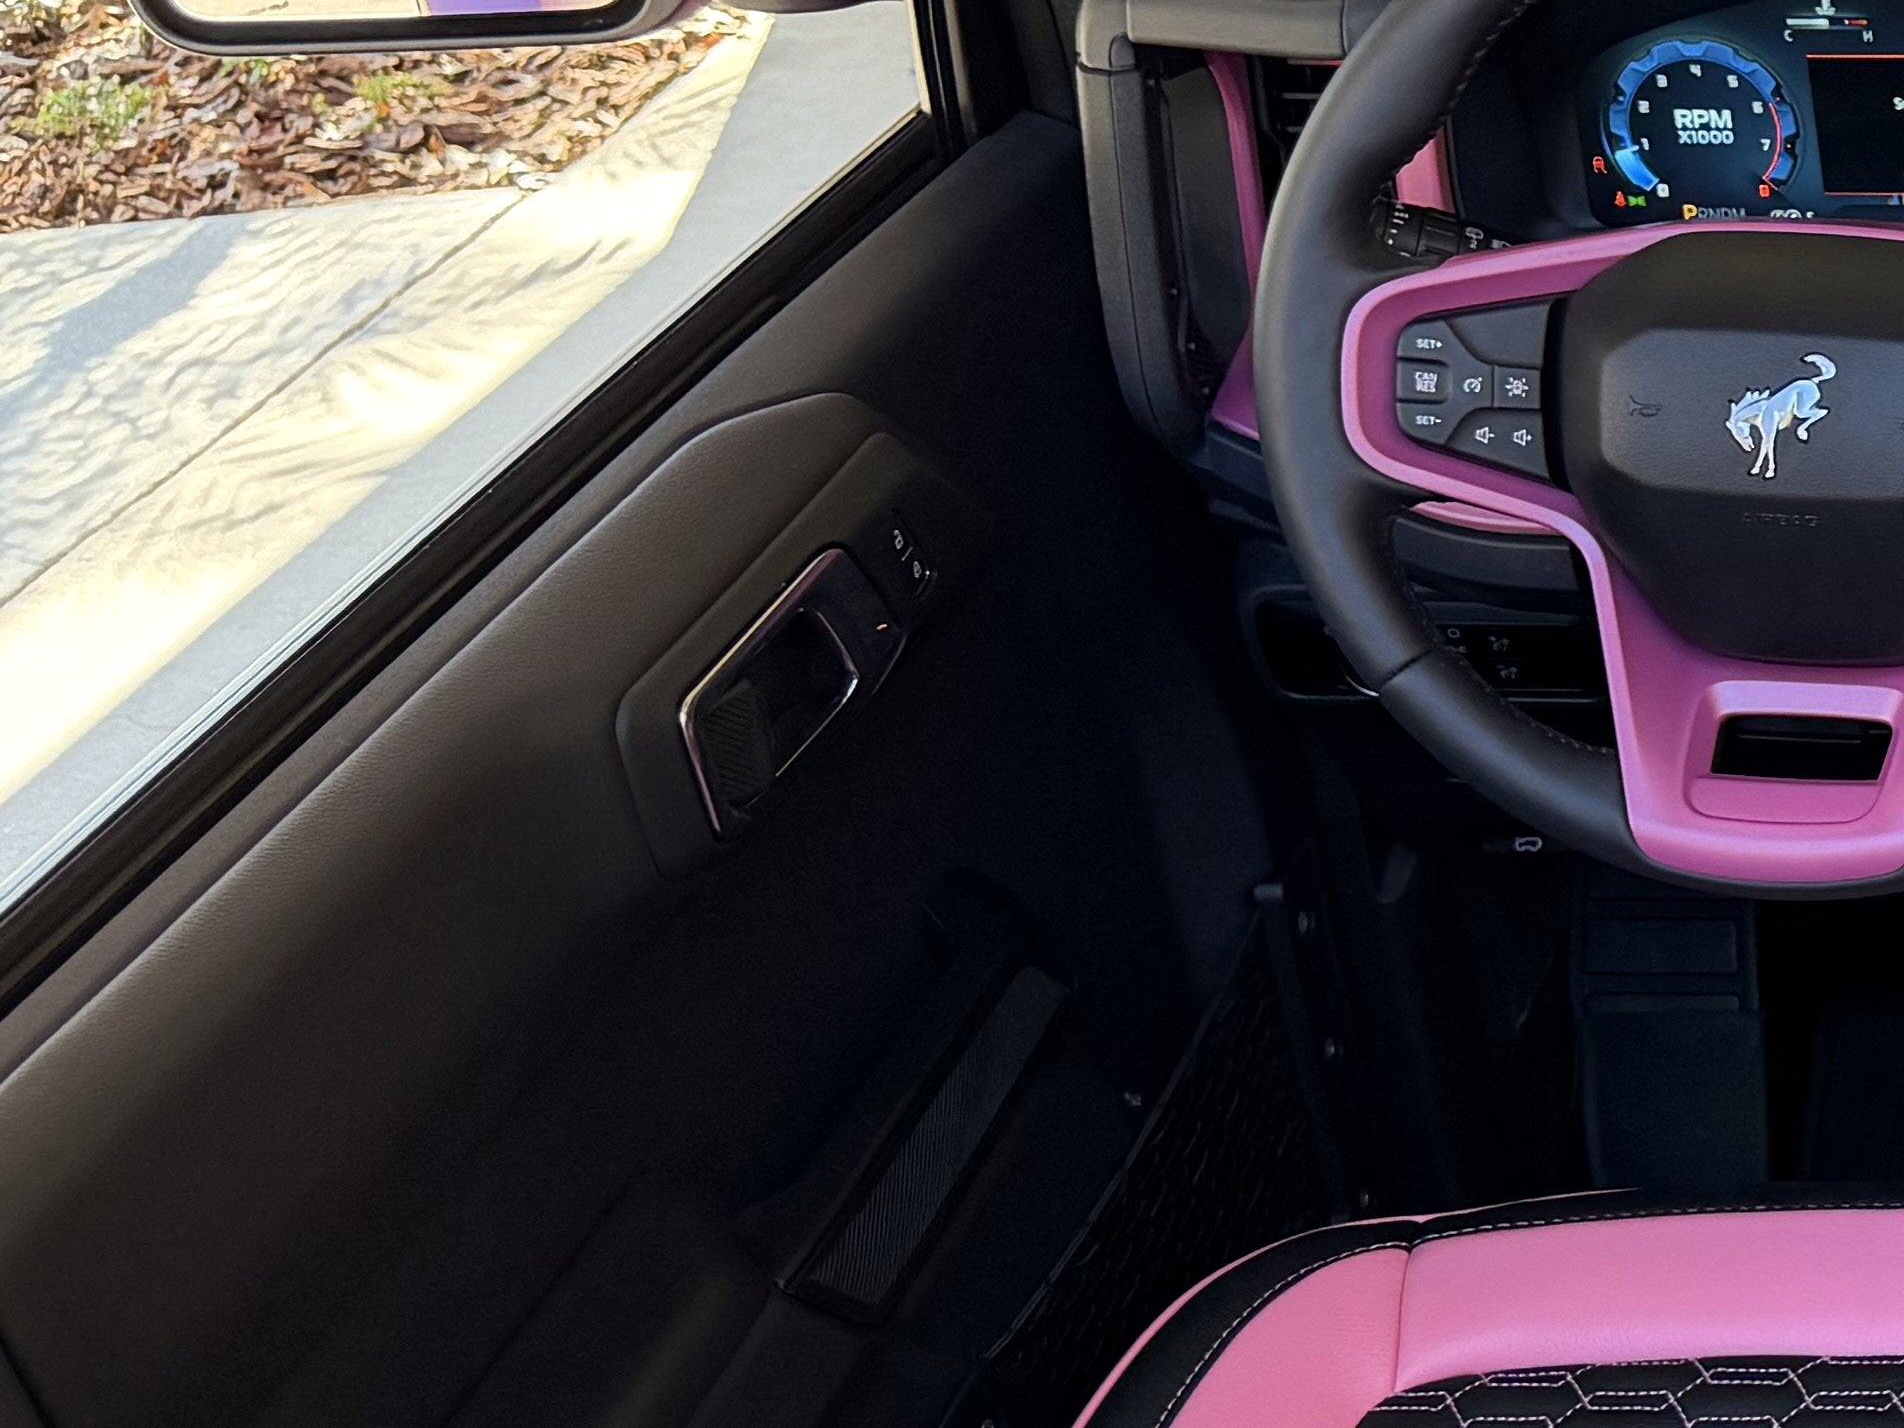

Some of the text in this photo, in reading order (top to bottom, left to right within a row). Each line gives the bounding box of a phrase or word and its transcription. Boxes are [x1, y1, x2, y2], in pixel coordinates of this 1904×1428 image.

[1784, 31, 1793, 42] C
[1863, 31, 1873, 43] H
[1673, 108, 1733, 129] RPM
[1678, 131, 1734, 145] X1000
